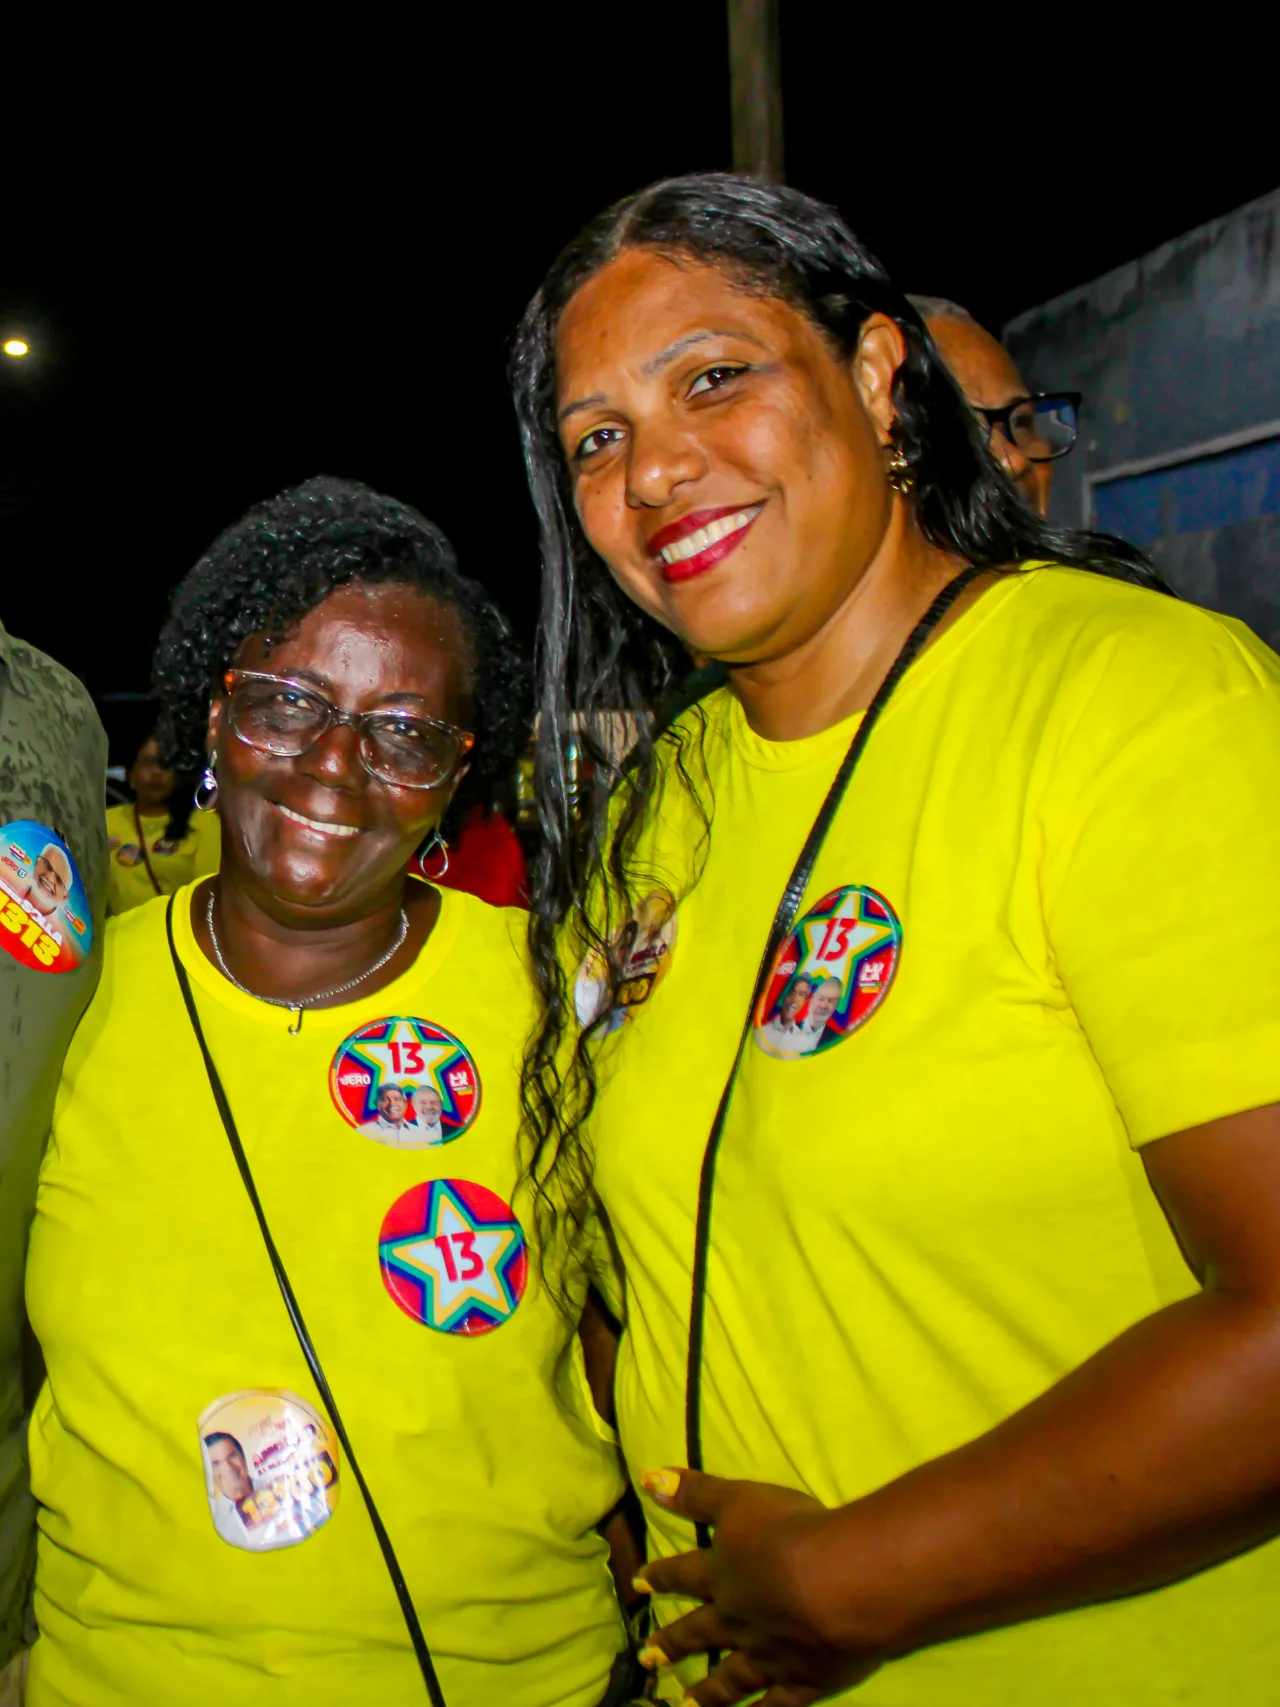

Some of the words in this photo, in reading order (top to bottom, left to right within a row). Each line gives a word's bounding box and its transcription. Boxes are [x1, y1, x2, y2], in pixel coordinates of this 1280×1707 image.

[816, 918, 858, 961] 13
[387, 1042, 425, 1074] 13
[339, 1073, 371, 1086] JERO
[434, 1231, 485, 1283] 13
